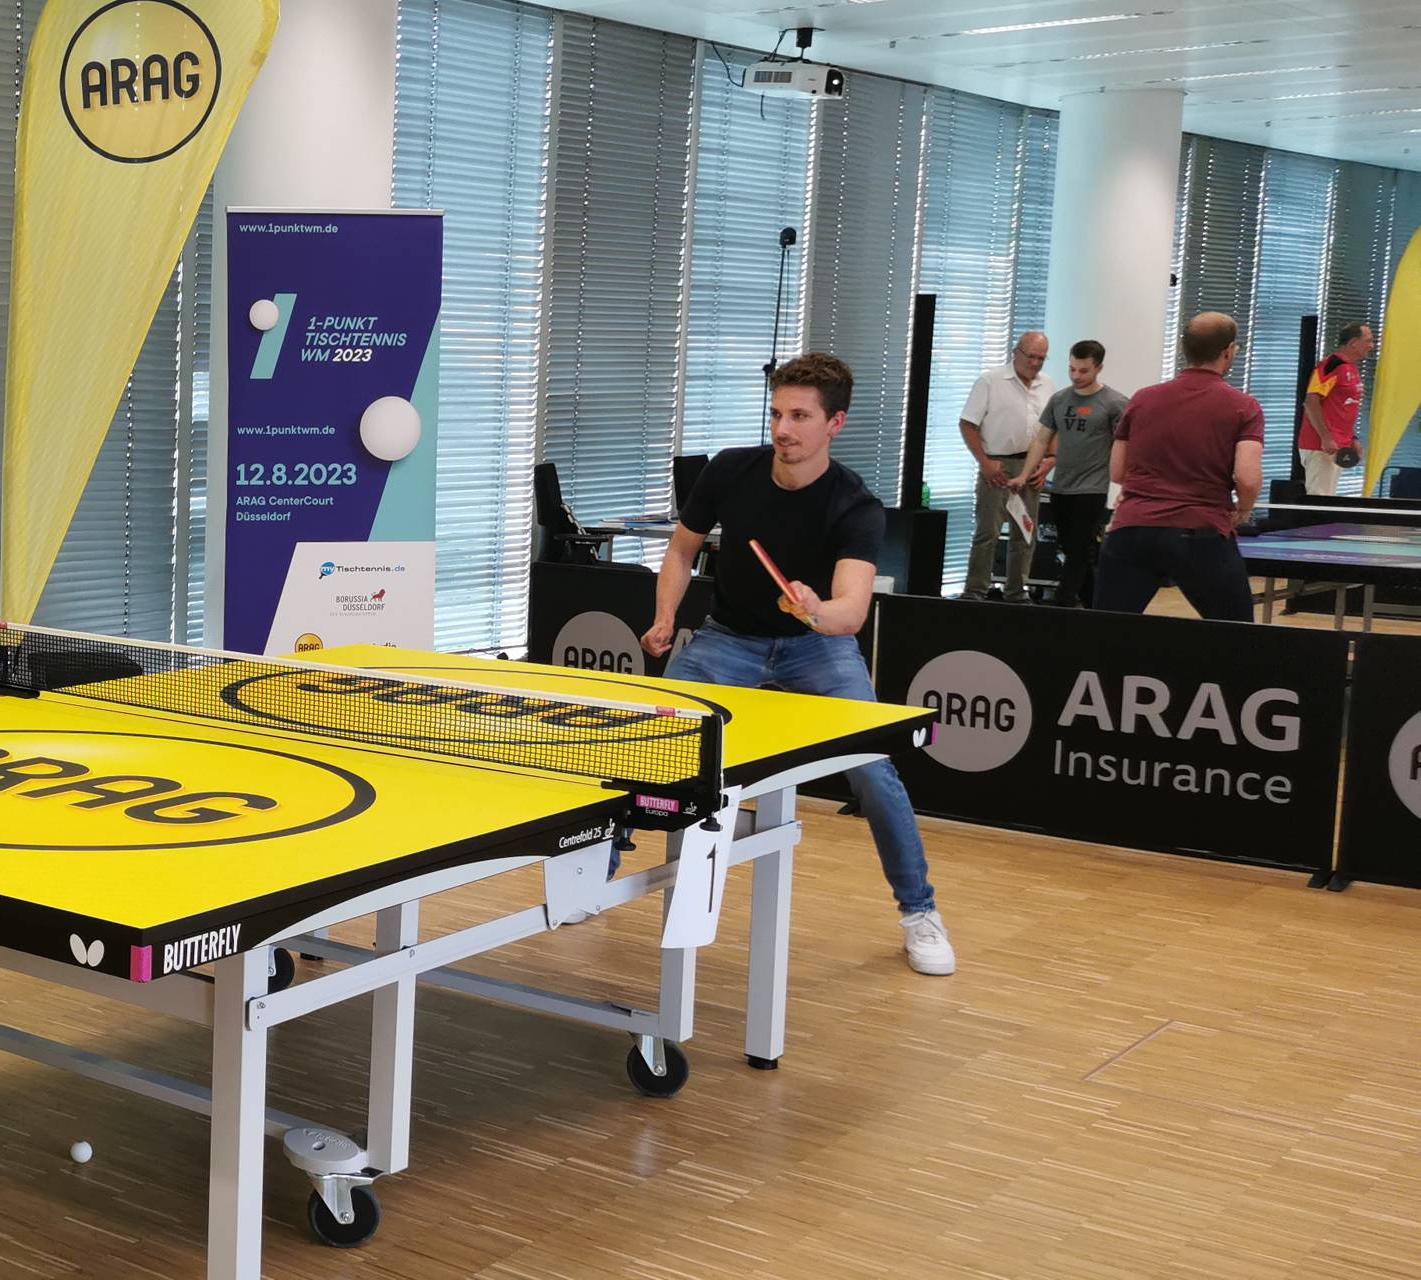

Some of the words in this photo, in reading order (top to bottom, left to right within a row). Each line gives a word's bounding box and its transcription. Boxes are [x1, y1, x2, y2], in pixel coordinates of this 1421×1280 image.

[81, 51, 199, 109] ARAG
[239, 223, 338, 235] www.1punktwm.de
[307, 316, 378, 330] 1-PUNKT
[305, 333, 407, 346] TISCHTENNIS
[301, 348, 330, 362] WM
[332, 348, 373, 362] 2023
[237, 425, 336, 437] www.1punktwm.de
[235, 463, 357, 485] 12.8.2023
[236, 496, 266, 505] ARAG
[269, 496, 334, 506] CenterCourt
[236, 512, 291, 521] Düsseldorf
[335, 595, 369, 603] BORUSSIA
[923, 690, 1016, 732] ARAG
[1057, 671, 1302, 752] ARAG
[1054, 739, 1292, 804] Insurance
[640, 796, 677, 812] BUTTERFLY
[645, 808, 669, 817] Europa
[558, 828, 592, 848] Centrefold
[592, 826, 602, 839] 25
[706, 843, 718, 913] 1
[163, 923, 242, 975] BUTTERFLY
